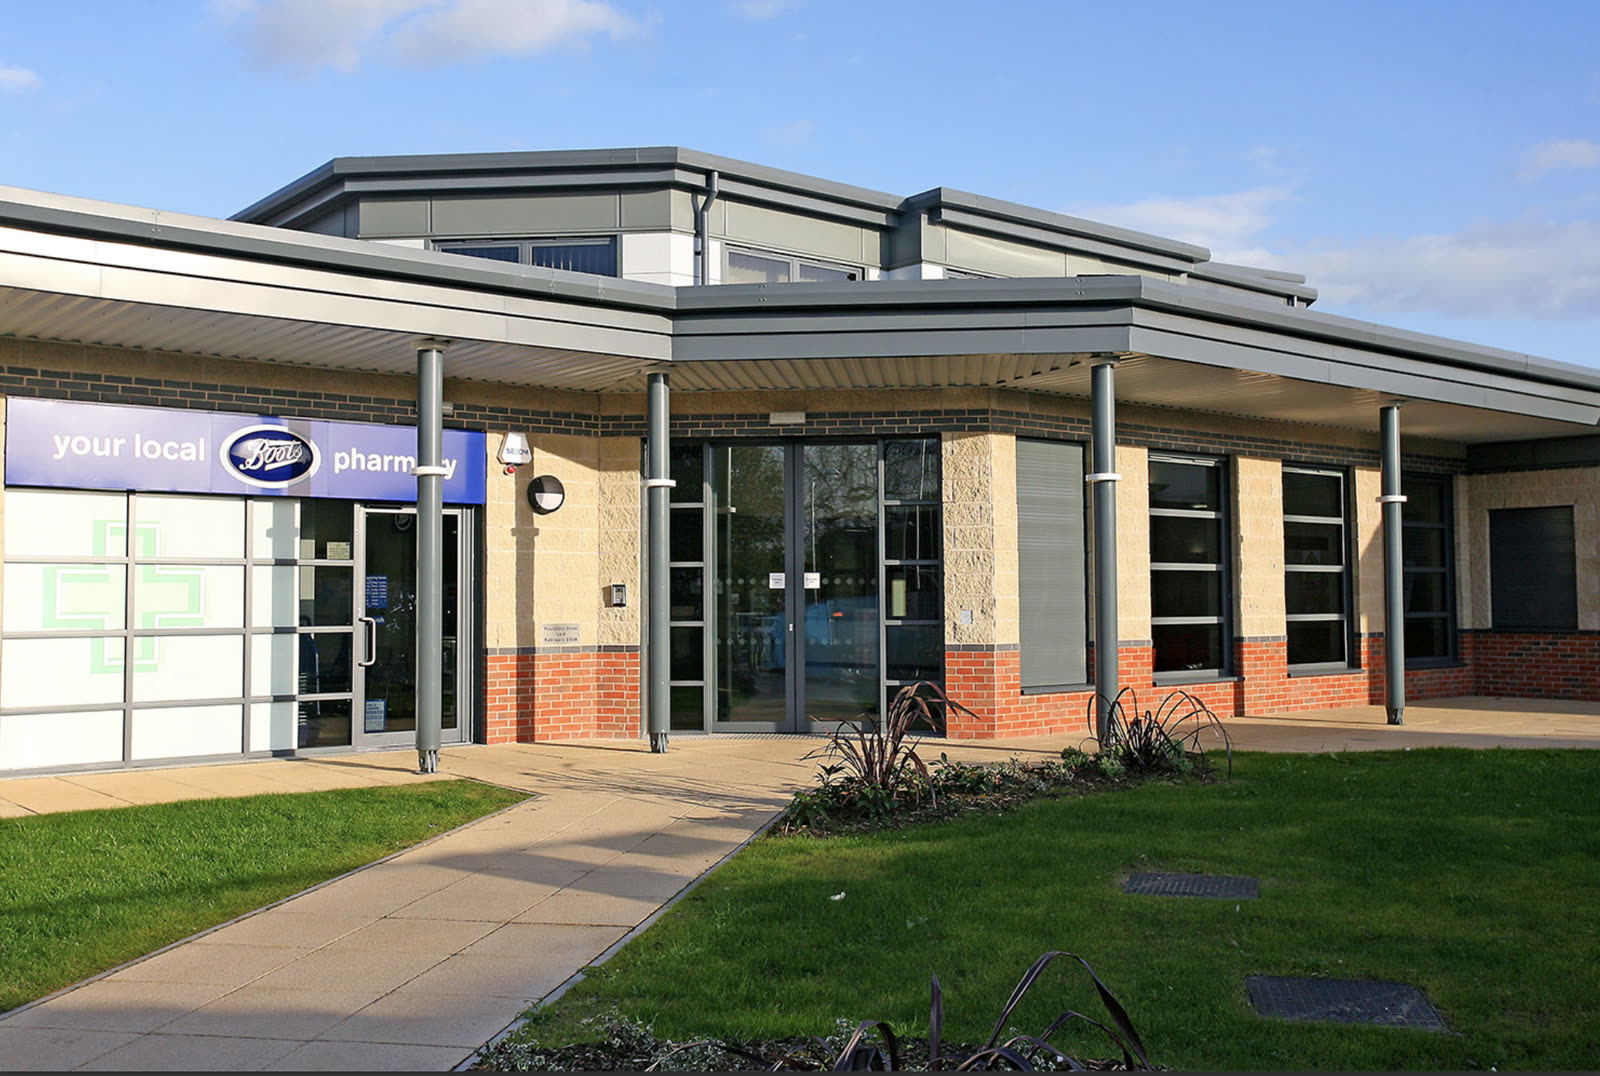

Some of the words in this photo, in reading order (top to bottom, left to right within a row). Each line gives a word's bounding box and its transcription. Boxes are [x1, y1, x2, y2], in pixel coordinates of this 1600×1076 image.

[53, 433, 125, 459] your
[134, 432, 204, 460] local
[239, 438, 303, 471] Boots
[334, 448, 458, 479] pharmy
